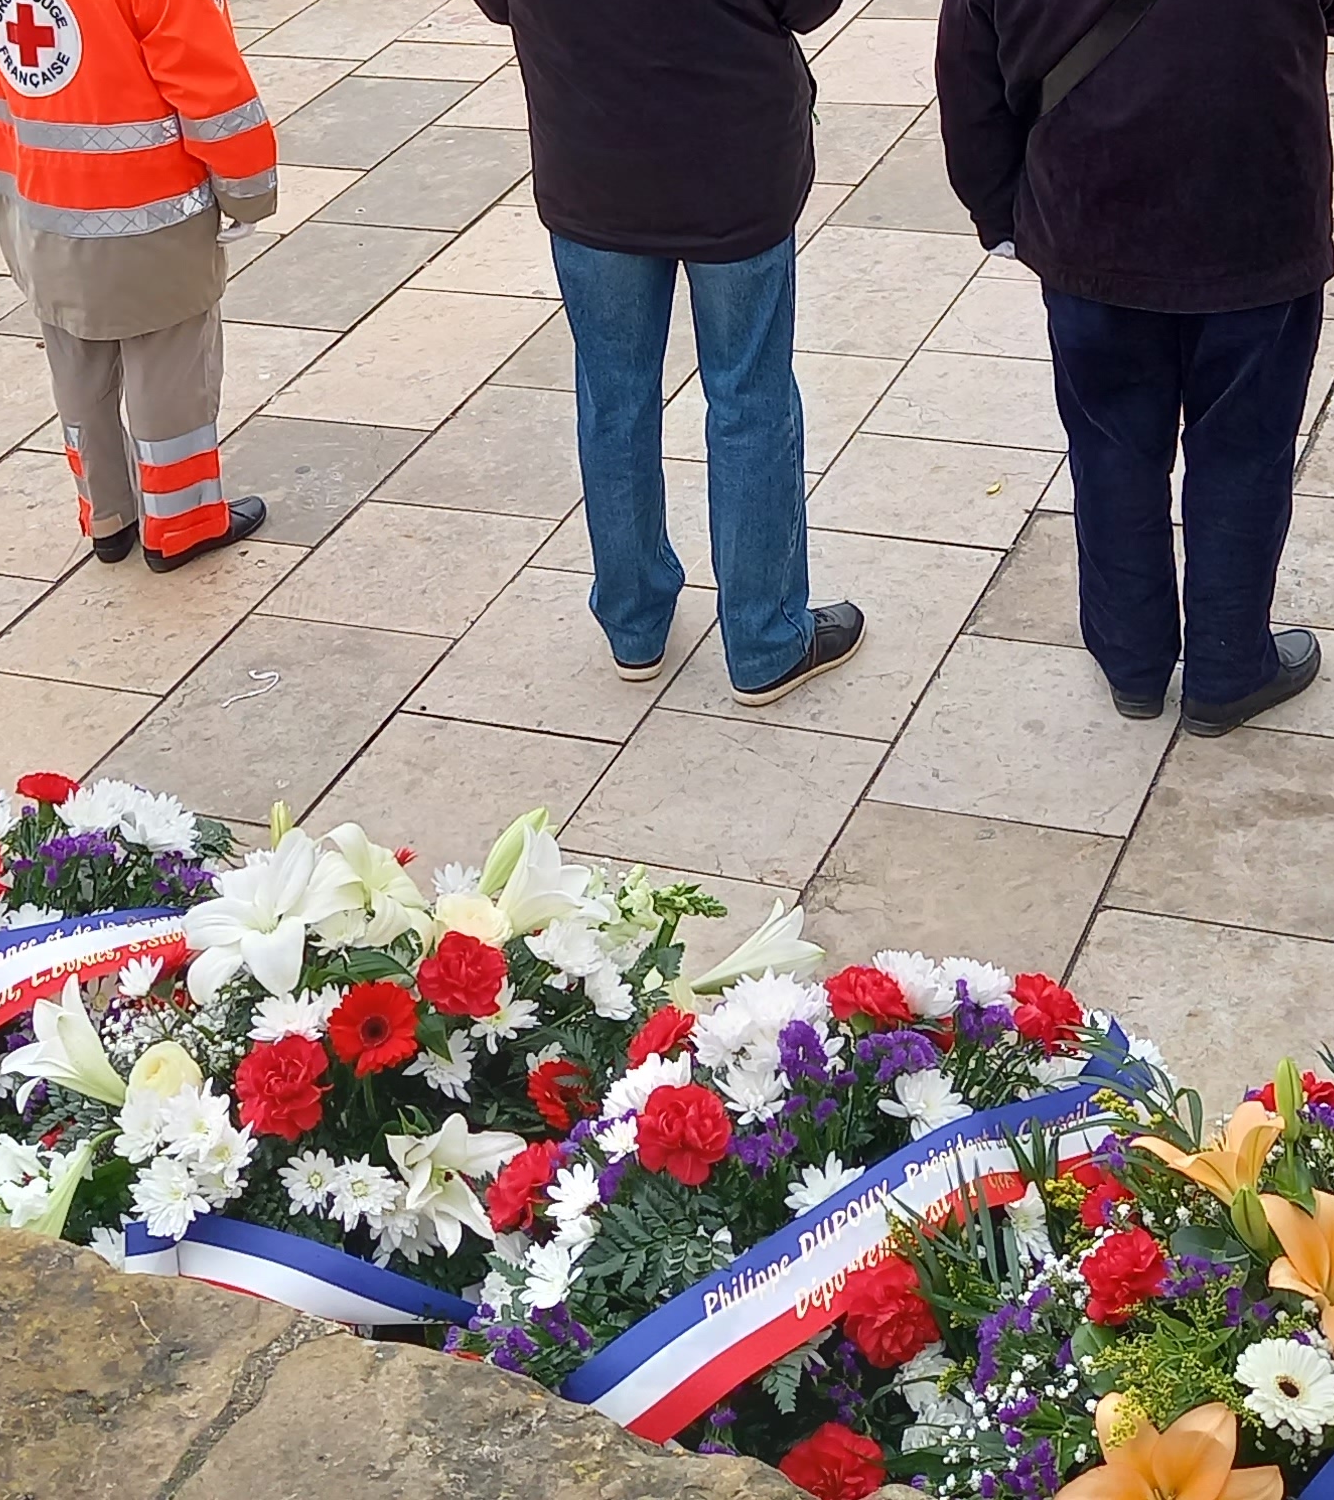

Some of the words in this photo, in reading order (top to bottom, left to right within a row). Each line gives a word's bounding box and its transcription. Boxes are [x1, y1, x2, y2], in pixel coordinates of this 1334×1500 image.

[45, 928, 65, 945] et
[72, 922, 92, 938] de
[99, 918, 117, 933] la
[701, 1253, 792, 1321] Philippe
[796, 1179, 889, 1263] DUPOUY
[903, 1127, 992, 1191] Président
